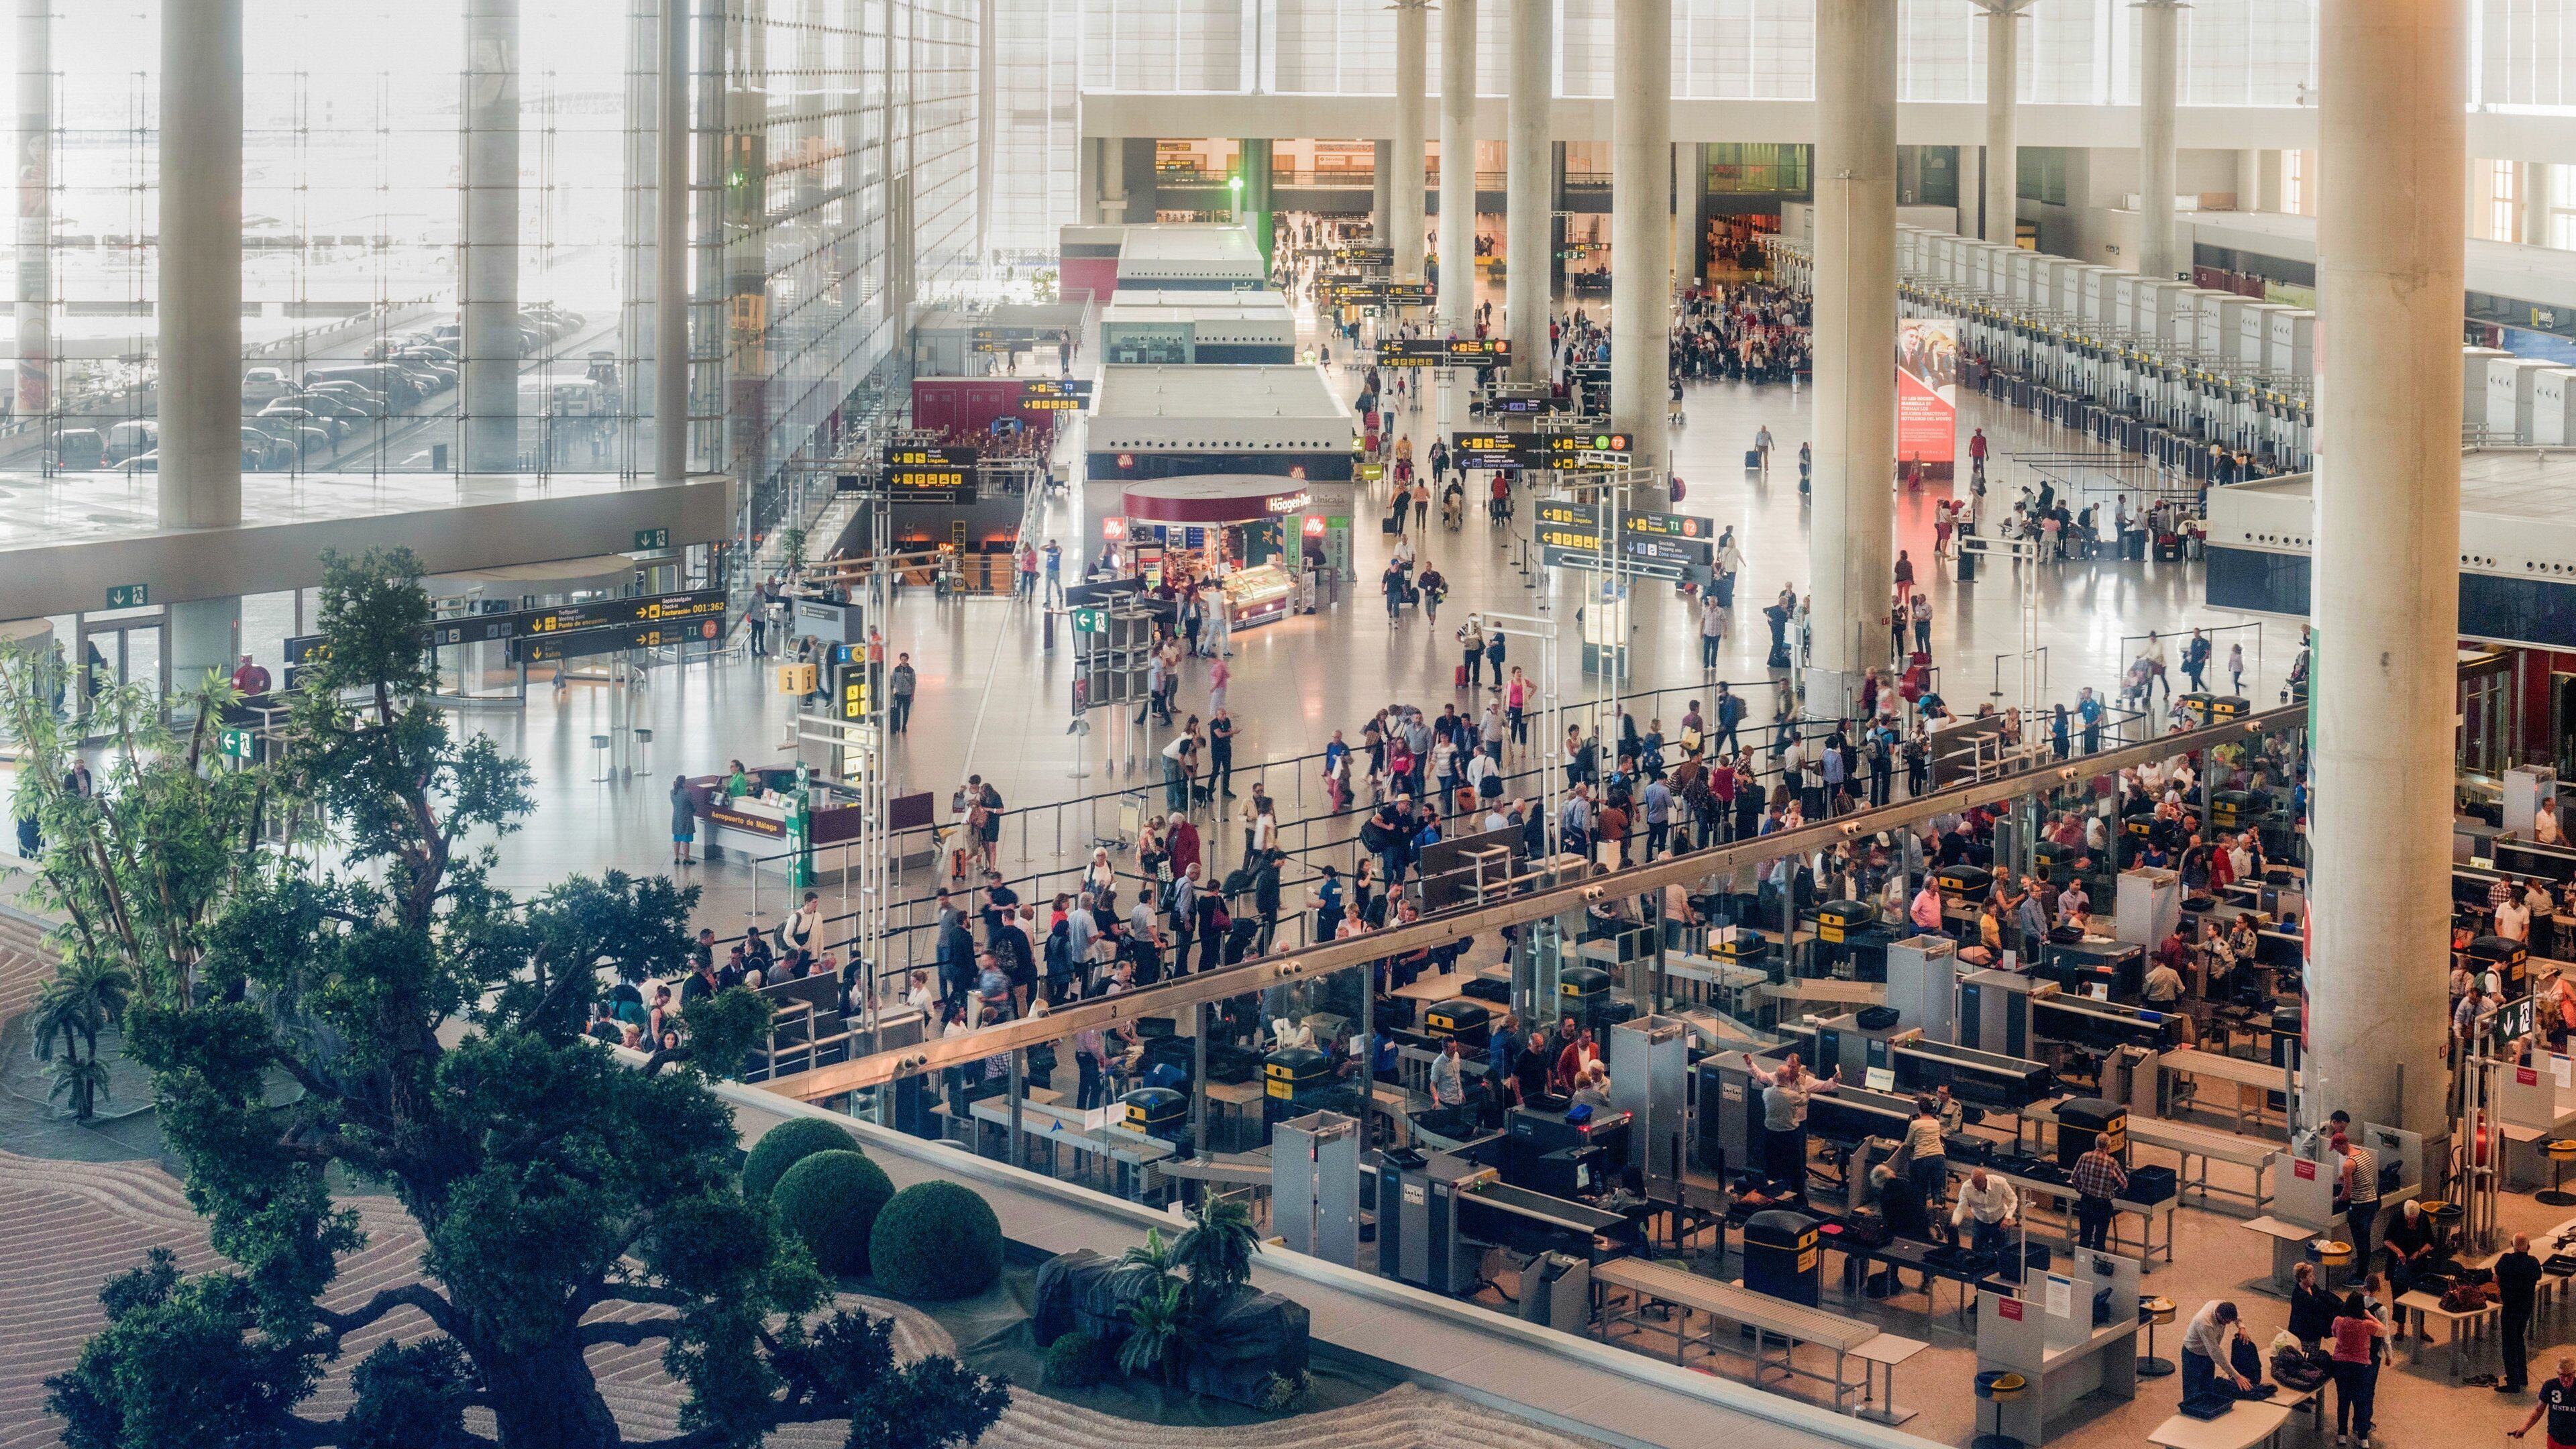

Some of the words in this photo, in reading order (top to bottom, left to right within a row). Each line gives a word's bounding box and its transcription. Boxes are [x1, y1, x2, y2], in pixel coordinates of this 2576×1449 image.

[1313, 494, 1345, 504] Unicaja
[1105, 522, 1122, 537] illy
[1306, 519, 1324, 534] illy
[1670, 521, 1680, 530] T1
[1685, 523, 1695, 531] T2
[662, 608, 691, 616] Facturación
[693, 602, 724, 613] 001:362
[687, 626, 697, 636] T1
[705, 625, 715, 634] T2
[796, 783, 808, 792] DEA
[1964, 794, 1968, 805] 6
[711, 810, 744, 824] Aeropuerto
[756, 820, 777, 832] Málaga
[1448, 923, 1452, 935] 4
[1112, 1005, 1116, 1018] 3
[1869, 1072, 1891, 1081] Rapiscan
[2551, 1389, 2562, 1403] 3
